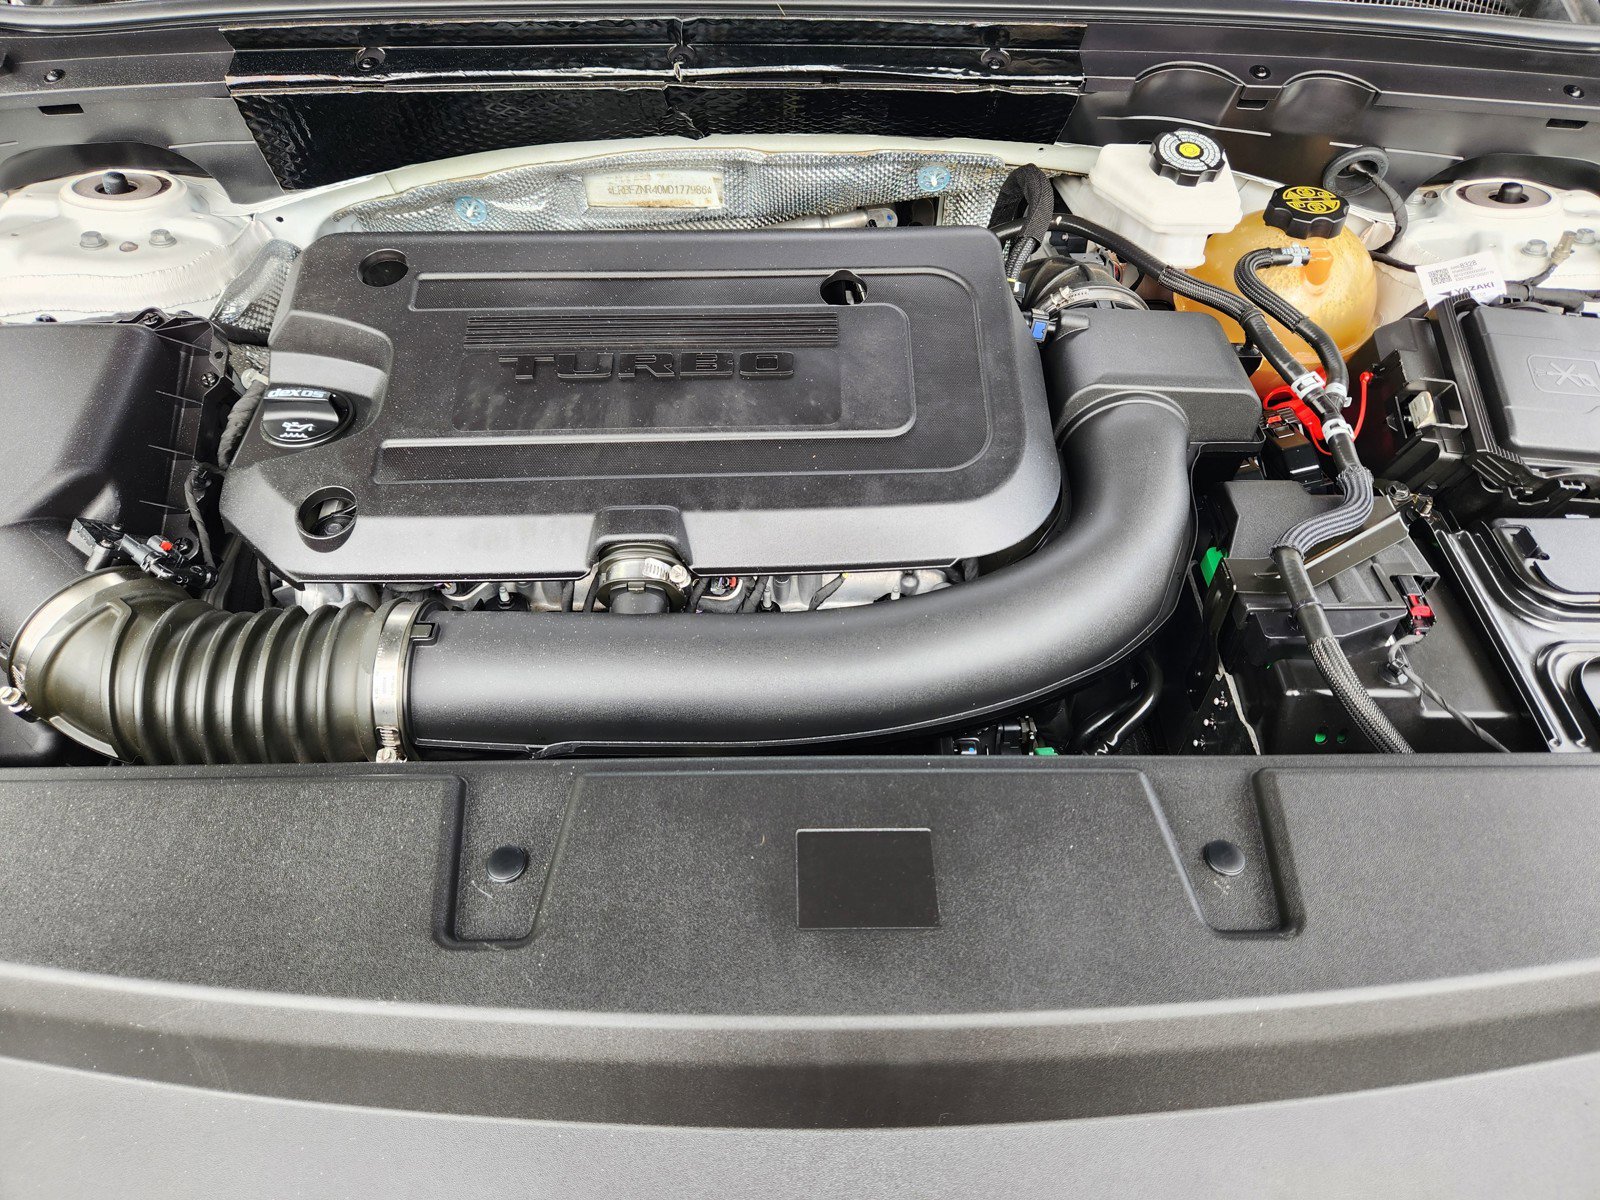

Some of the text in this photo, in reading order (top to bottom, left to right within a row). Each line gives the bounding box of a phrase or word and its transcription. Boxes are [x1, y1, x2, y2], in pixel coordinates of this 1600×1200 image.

[1455, 281, 1495, 296] YAZAKI
[498, 351, 795, 379] TURBO
[267, 388, 325, 398] dexos
